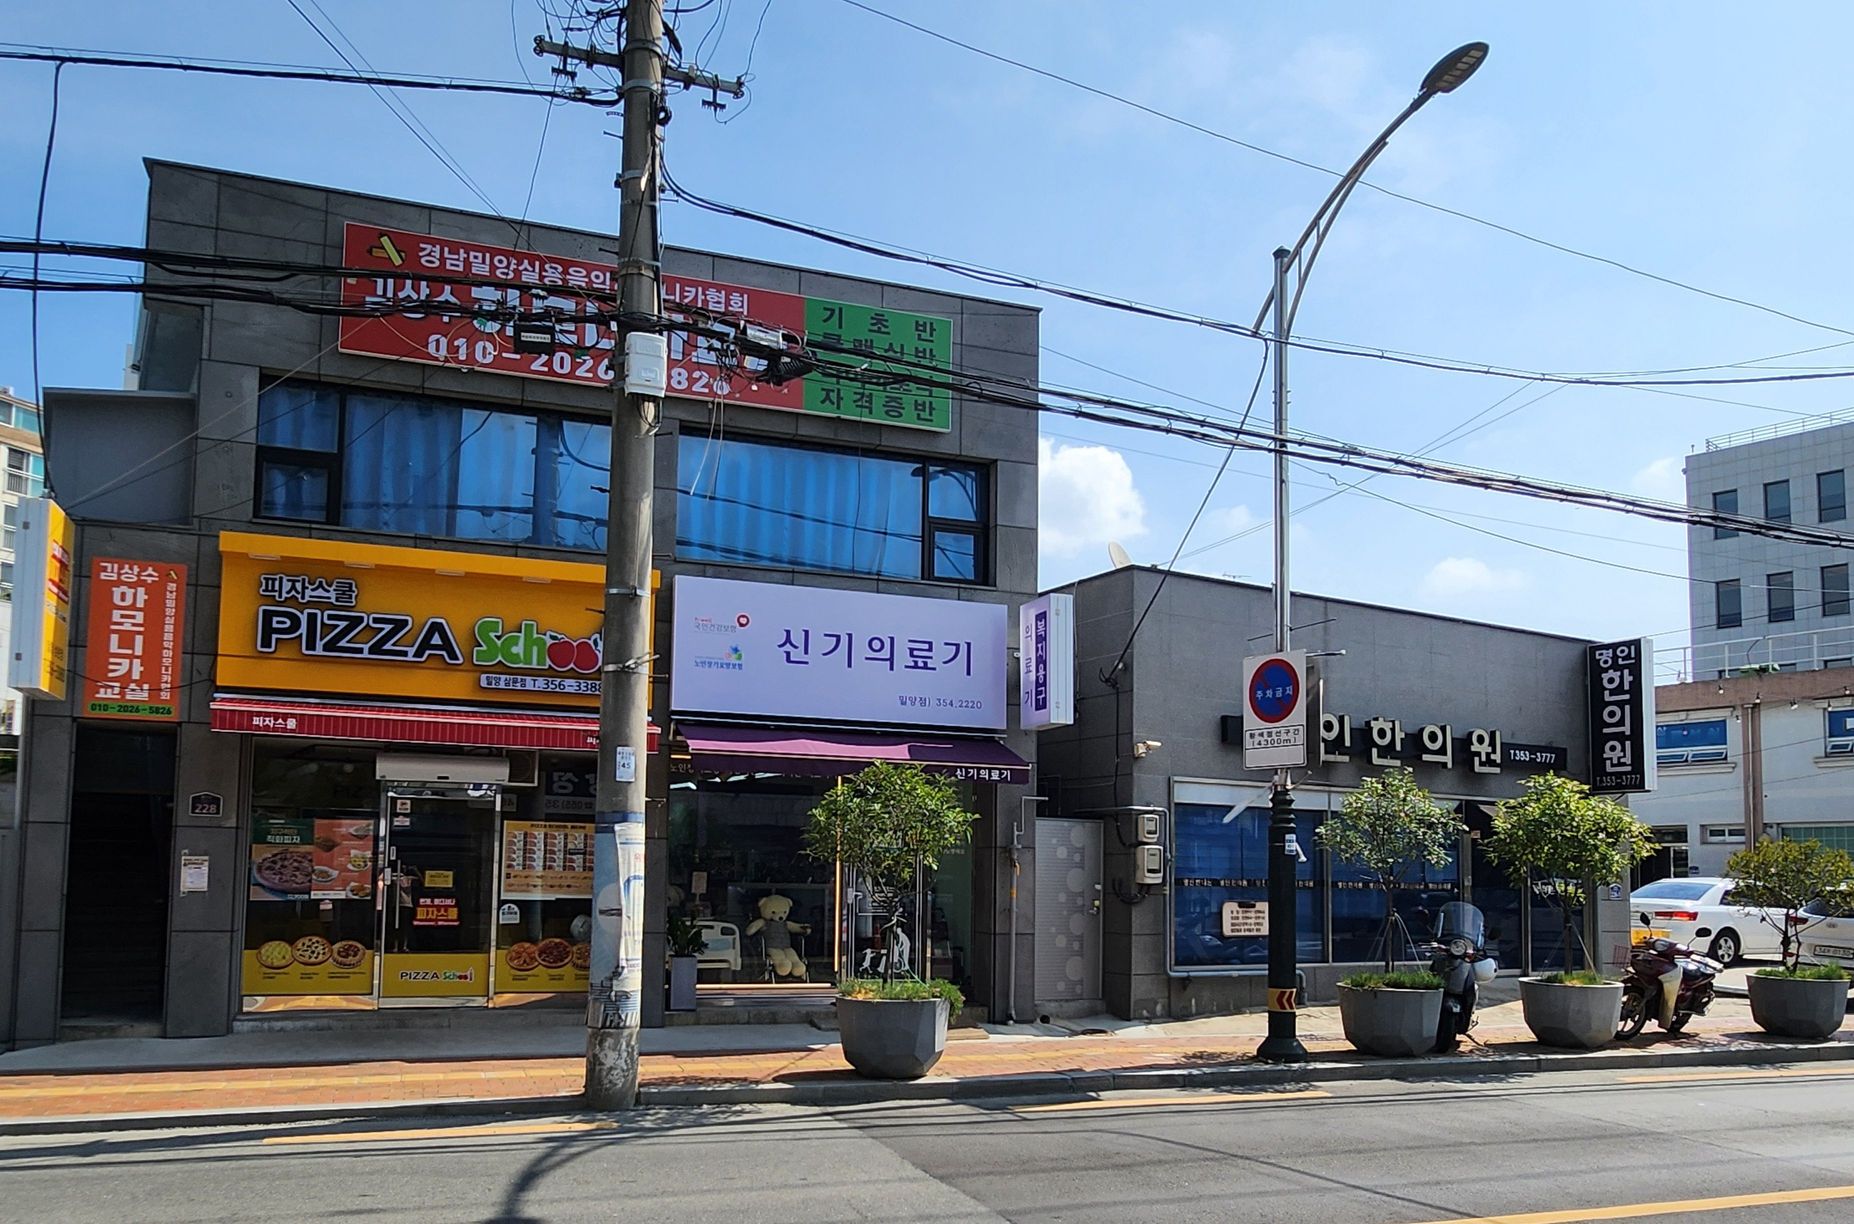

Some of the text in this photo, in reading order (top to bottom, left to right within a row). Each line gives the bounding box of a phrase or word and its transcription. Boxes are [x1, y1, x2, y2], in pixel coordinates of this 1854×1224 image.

[99, 562, 160, 583] 김상수
[260, 574, 358, 606] 피자스쿨
[257, 605, 464, 664] PIZZA
[777, 628, 974, 677] 신기의료기
[1036, 618, 1046, 706] 복지용구
[1595, 645, 1636, 668] 명인
[1256, 685, 1293, 700] 주차금지
[90, 702, 173, 716] 010-2026-5826
[935, 697, 983, 710] 354.2220
[252, 716, 297, 729] 피자스쿨
[1601, 668, 1634, 773] 한의원
[1321, 712, 1501, 774] 인한의원
[955, 767, 1012, 782] 신기의료기
[194, 803, 217, 814] 228
[400, 970, 440, 981] PIZZA
